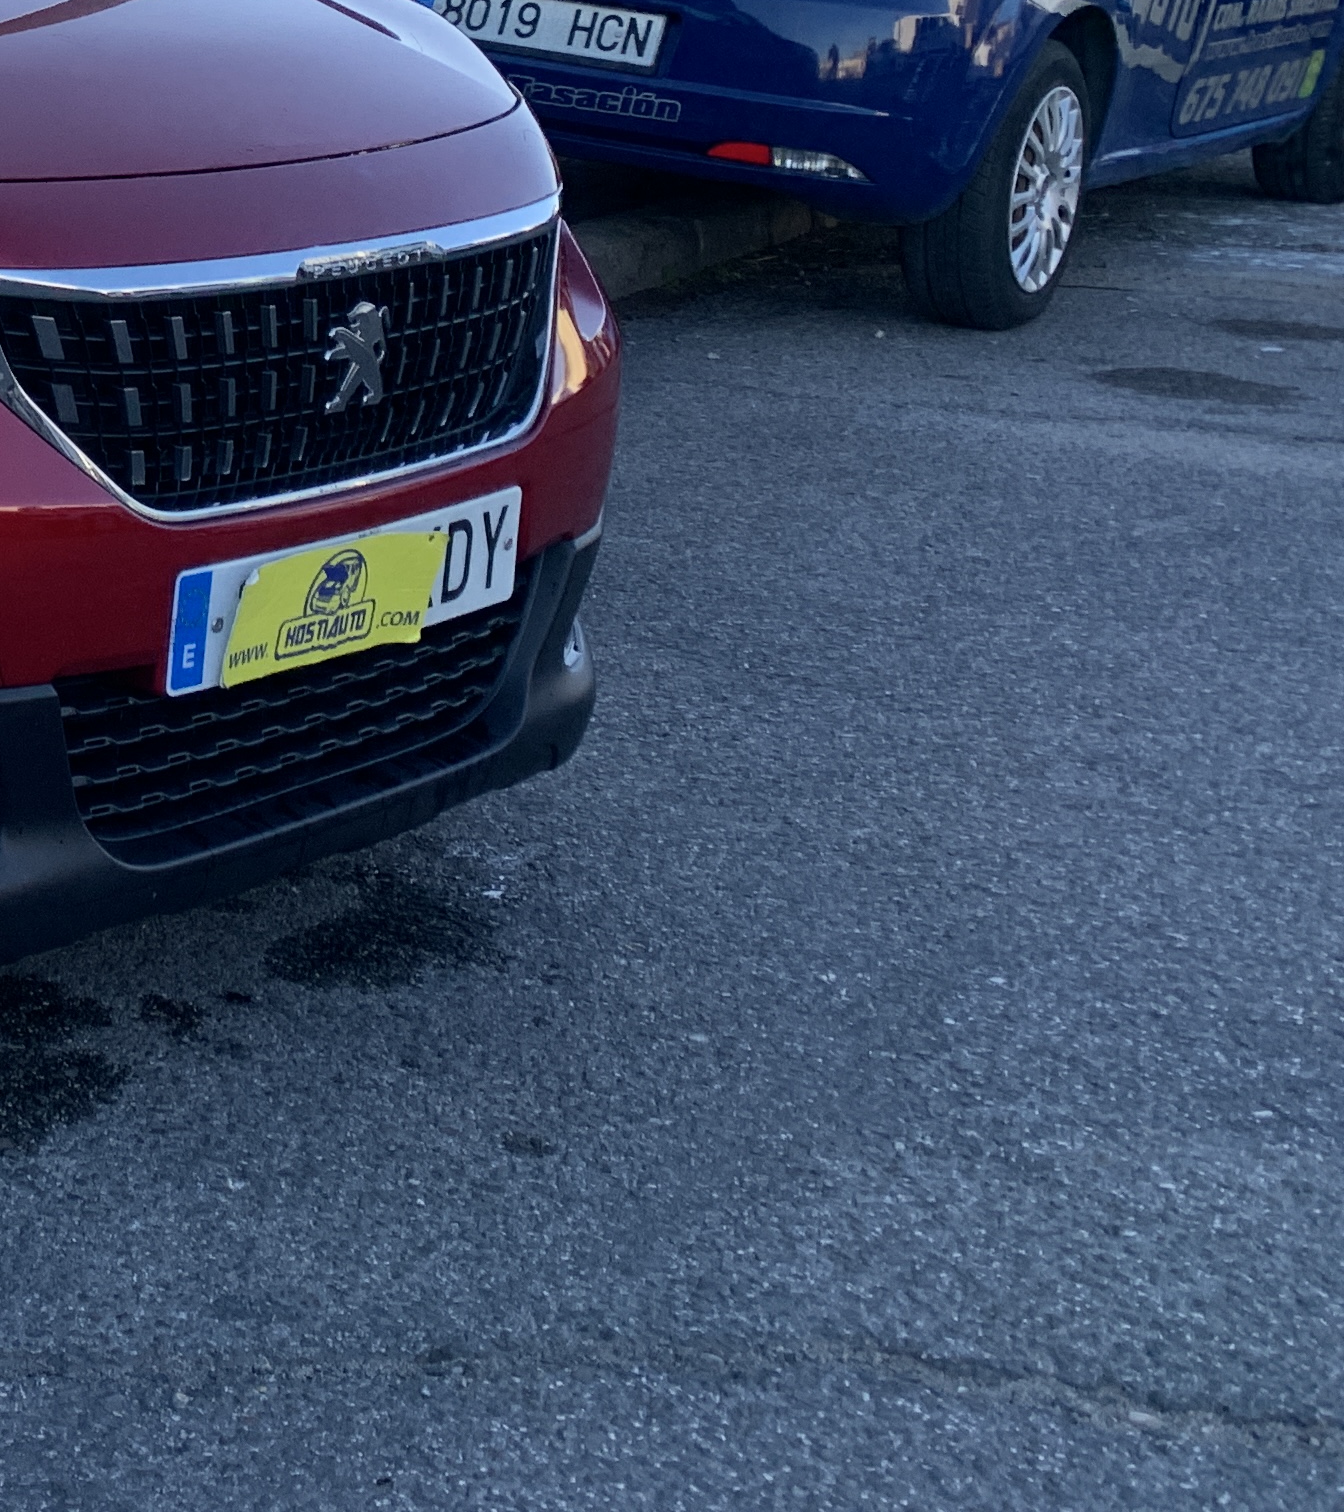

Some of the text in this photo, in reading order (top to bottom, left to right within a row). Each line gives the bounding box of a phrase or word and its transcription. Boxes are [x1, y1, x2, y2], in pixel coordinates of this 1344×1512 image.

[567, 9, 653, 58] HCN
[313, 249, 423, 279] PEUGEOT
[428, 505, 509, 609] DY
[285, 608, 367, 649] HOSTIAUTO
[183, 643, 196, 669] E
